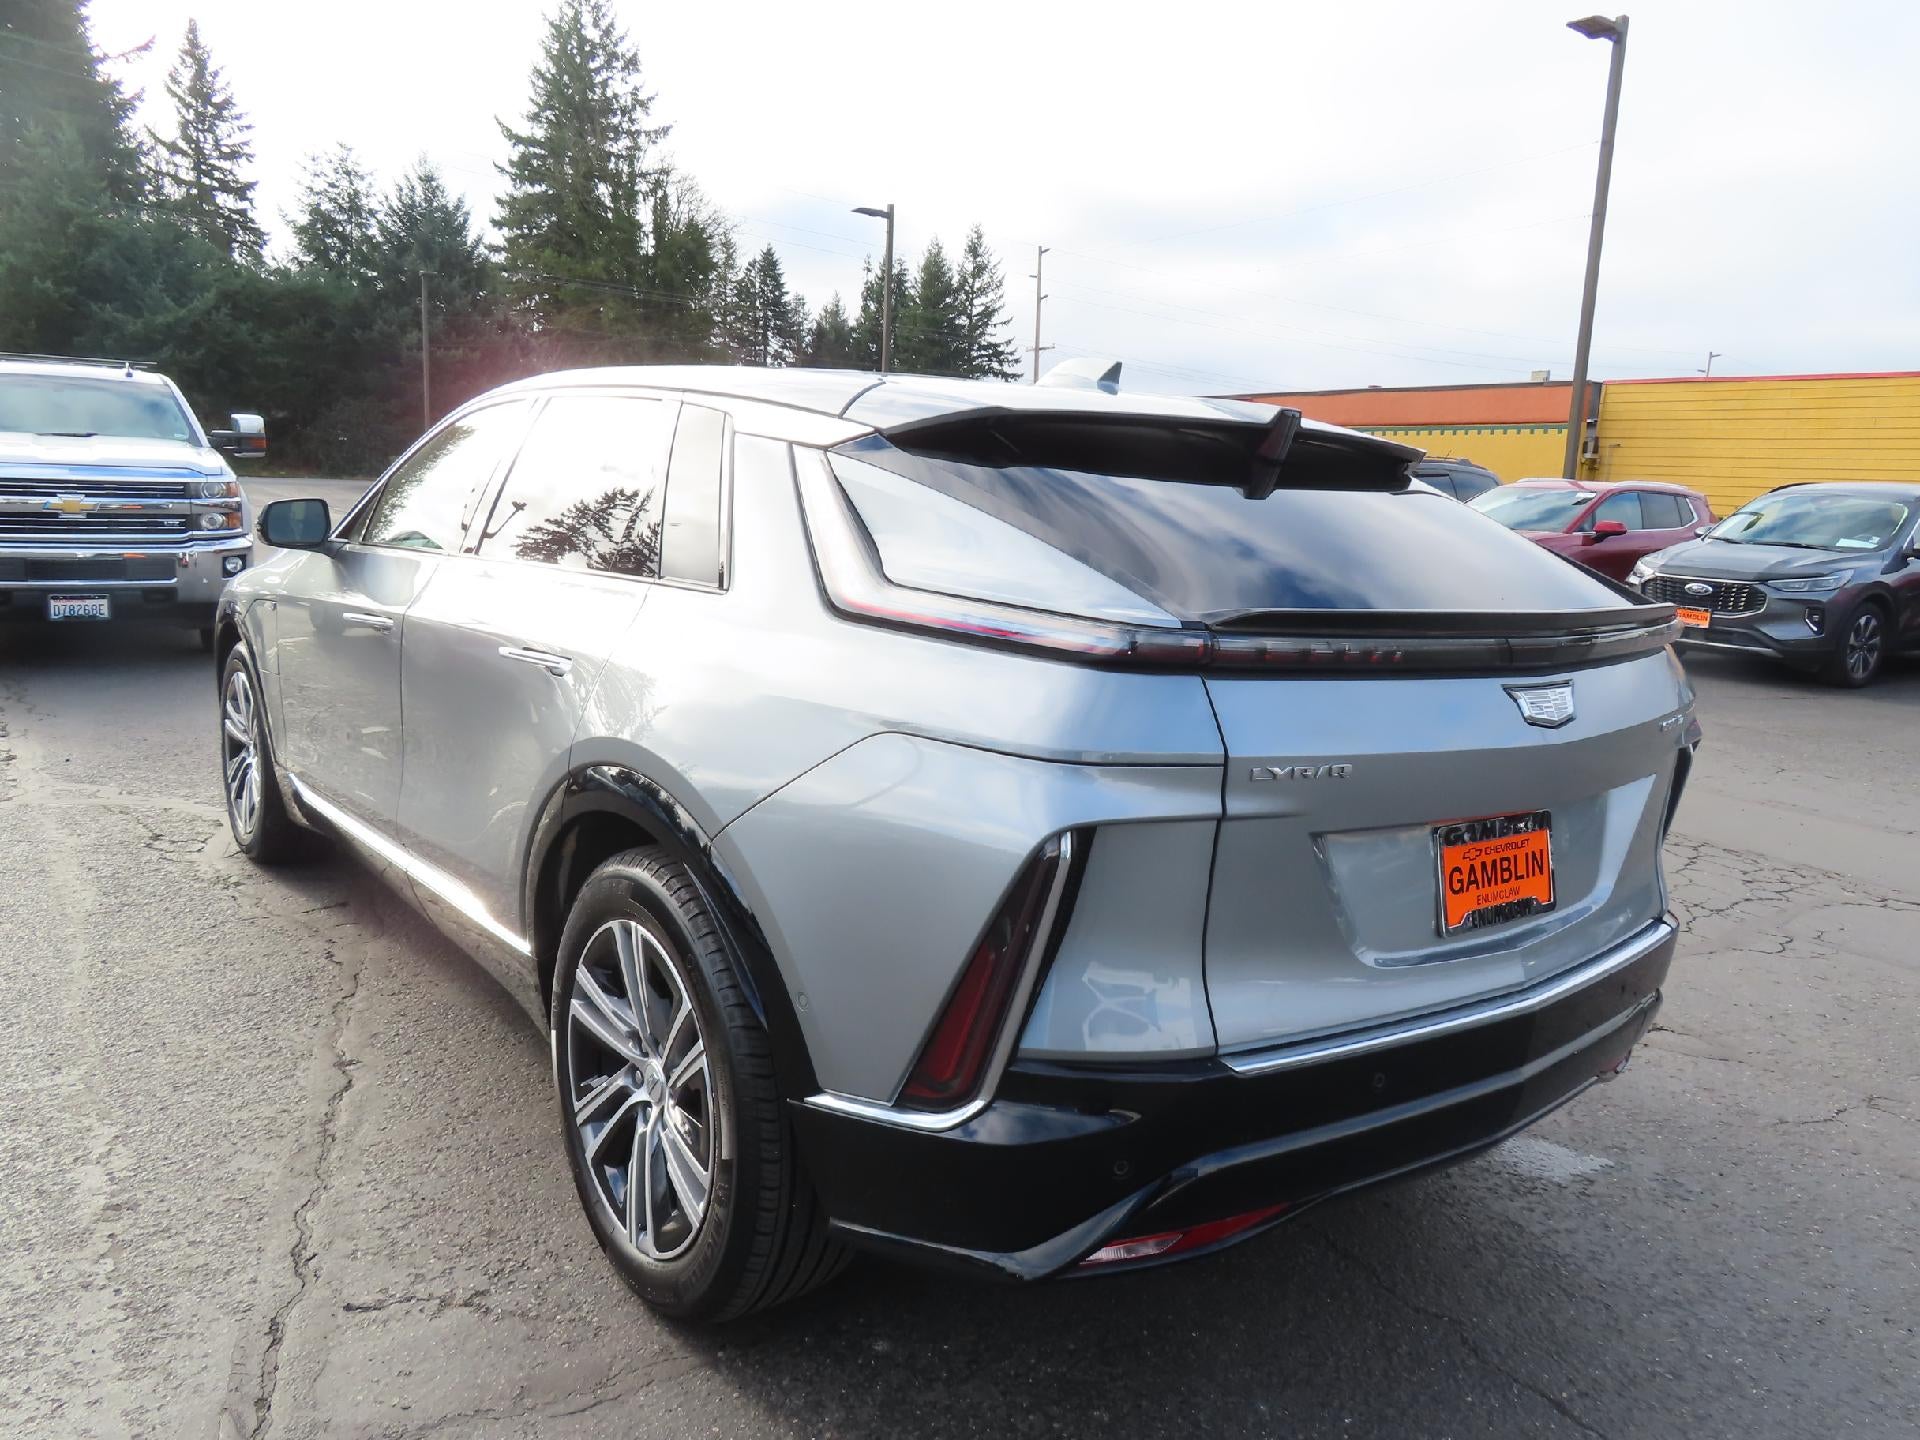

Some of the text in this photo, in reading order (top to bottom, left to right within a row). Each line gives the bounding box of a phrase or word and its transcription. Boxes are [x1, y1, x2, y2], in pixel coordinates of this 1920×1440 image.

[1484, 838, 1530, 856] CHEVROLET
[1448, 849, 1544, 895] GAMBLIN
[1476, 886, 1521, 906] ENUMCLAW
